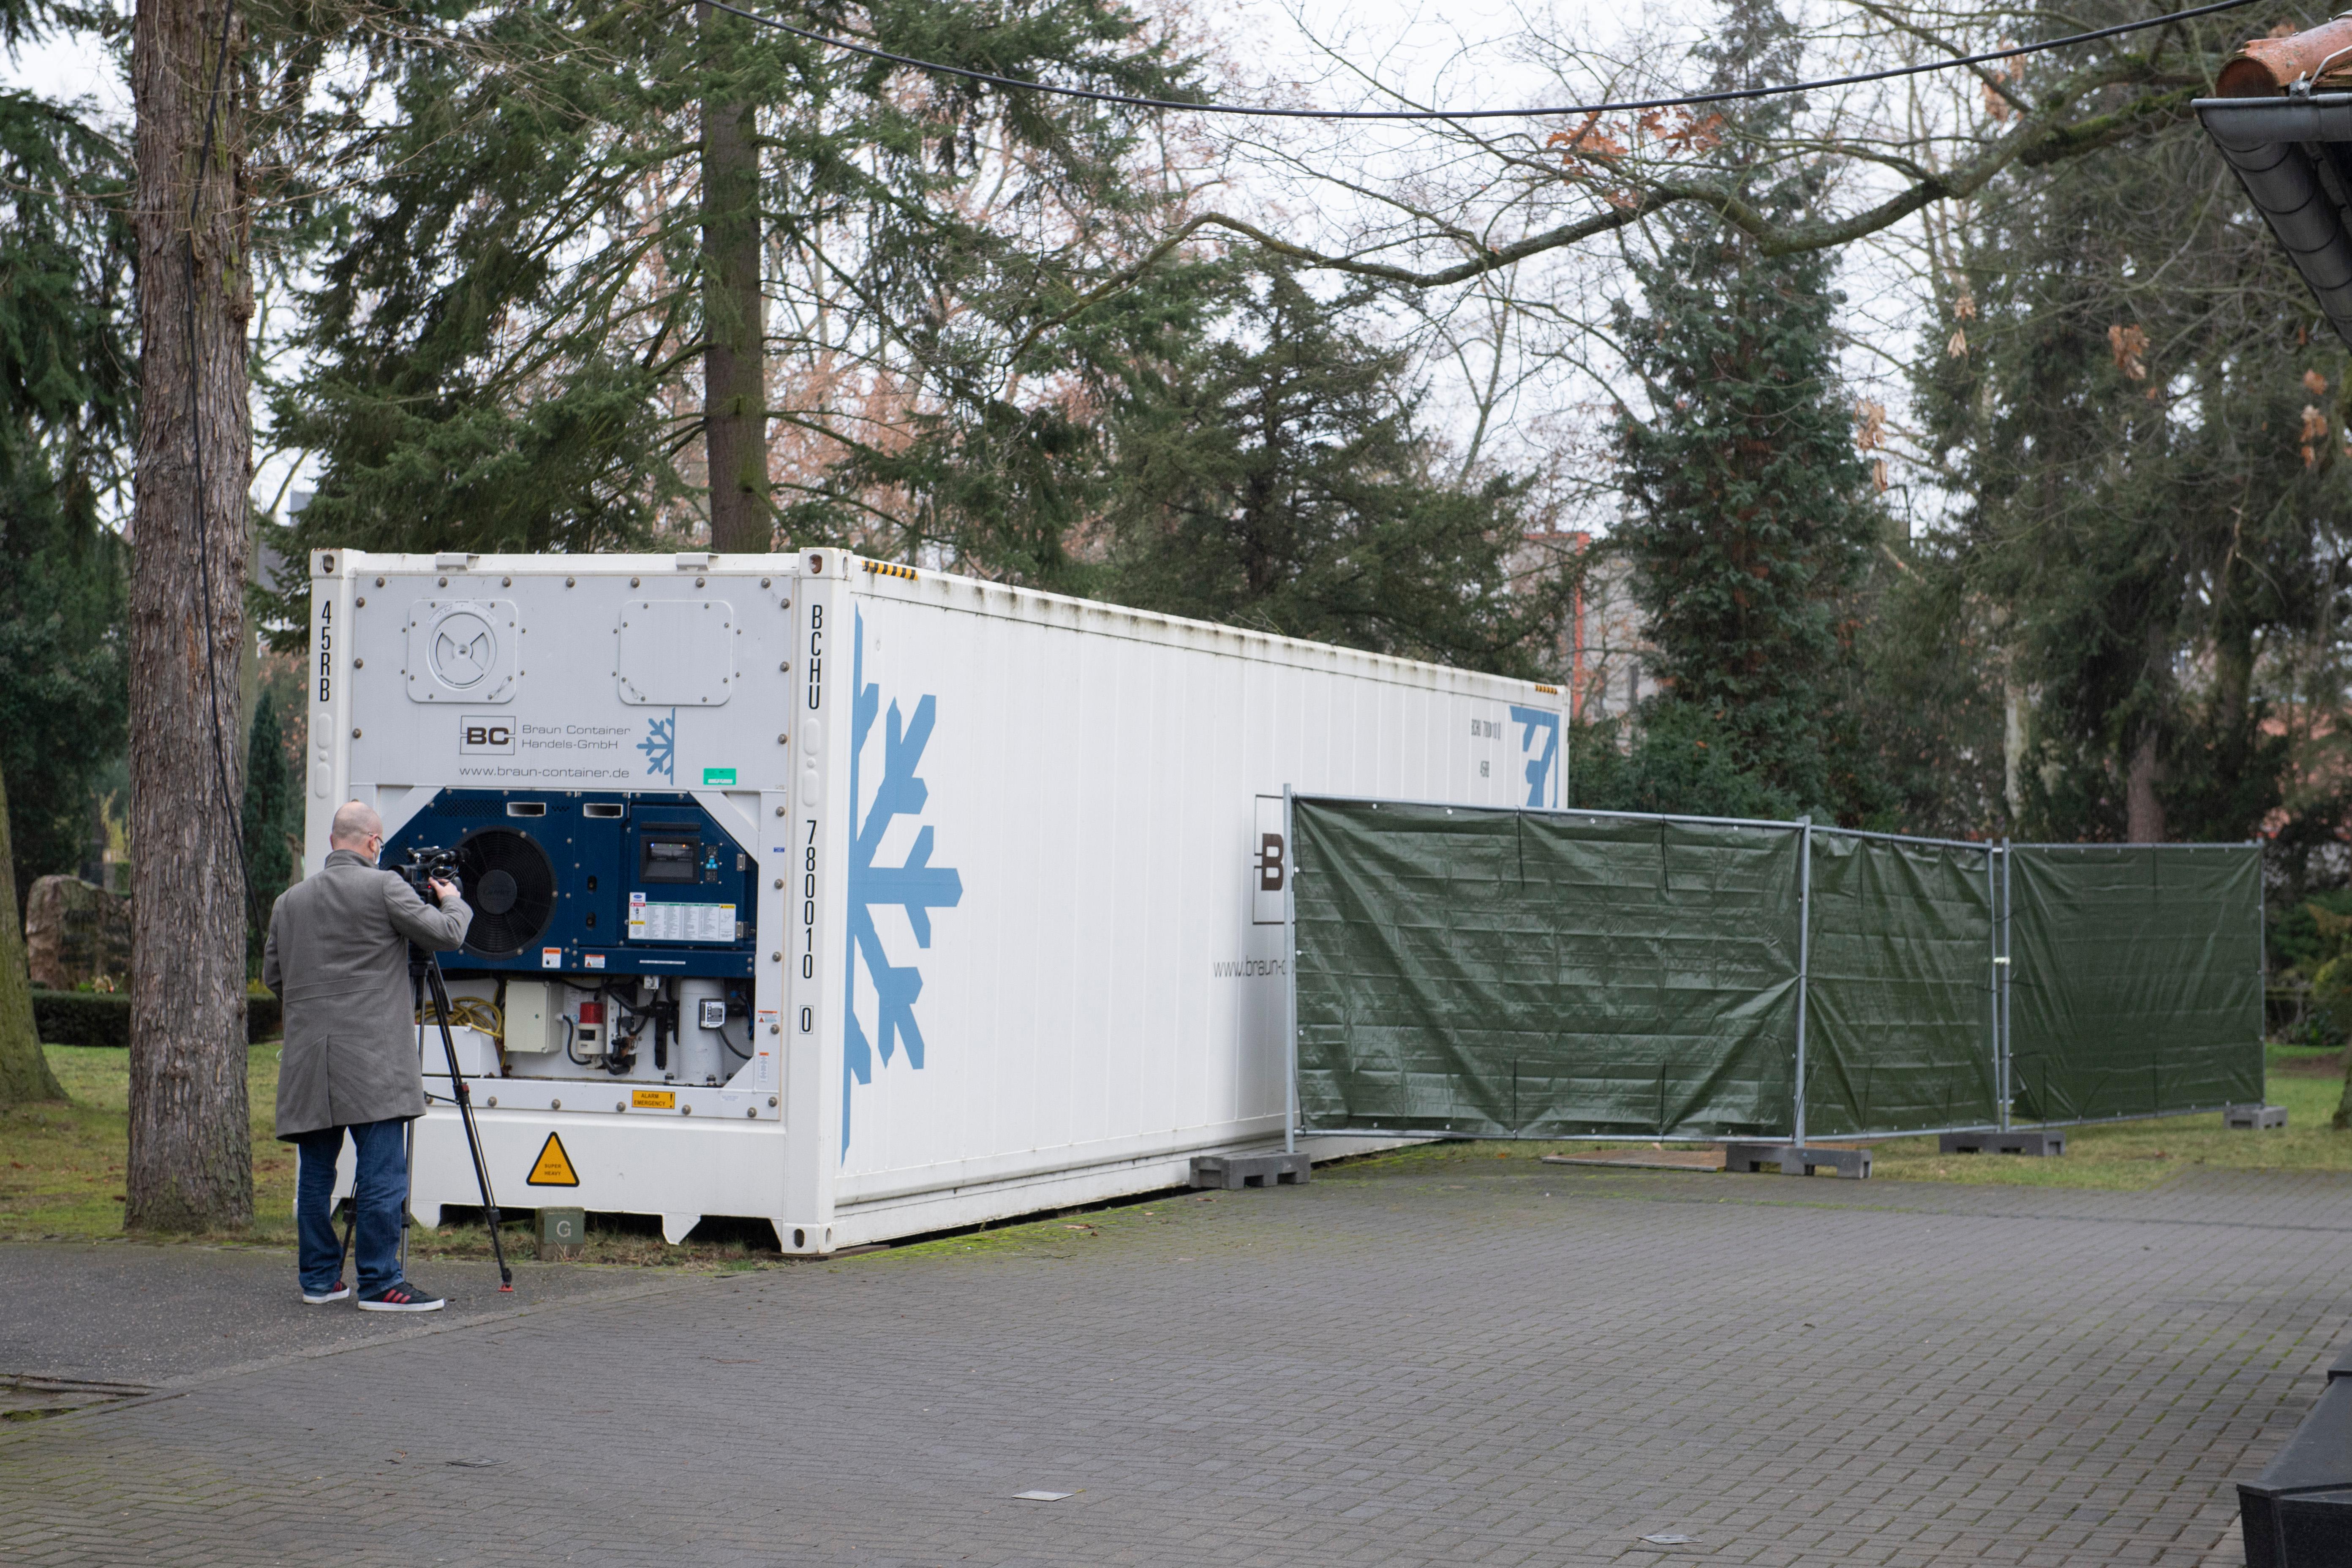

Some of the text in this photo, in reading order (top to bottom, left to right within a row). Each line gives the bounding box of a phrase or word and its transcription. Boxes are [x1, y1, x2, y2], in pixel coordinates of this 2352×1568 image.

[320, 600, 332, 702] 45RB
[809, 604, 822, 710] BCHU
[466, 727, 509, 745] BC
[522, 724, 630, 735] Braun Container
[522, 739, 618, 749] Handels-GmbH
[459, 766, 629, 779] www.braun-container.de
[1260, 833, 1285, 891] B
[802, 820, 817, 1032] 780010 0
[556, 1220, 571, 1238] G
